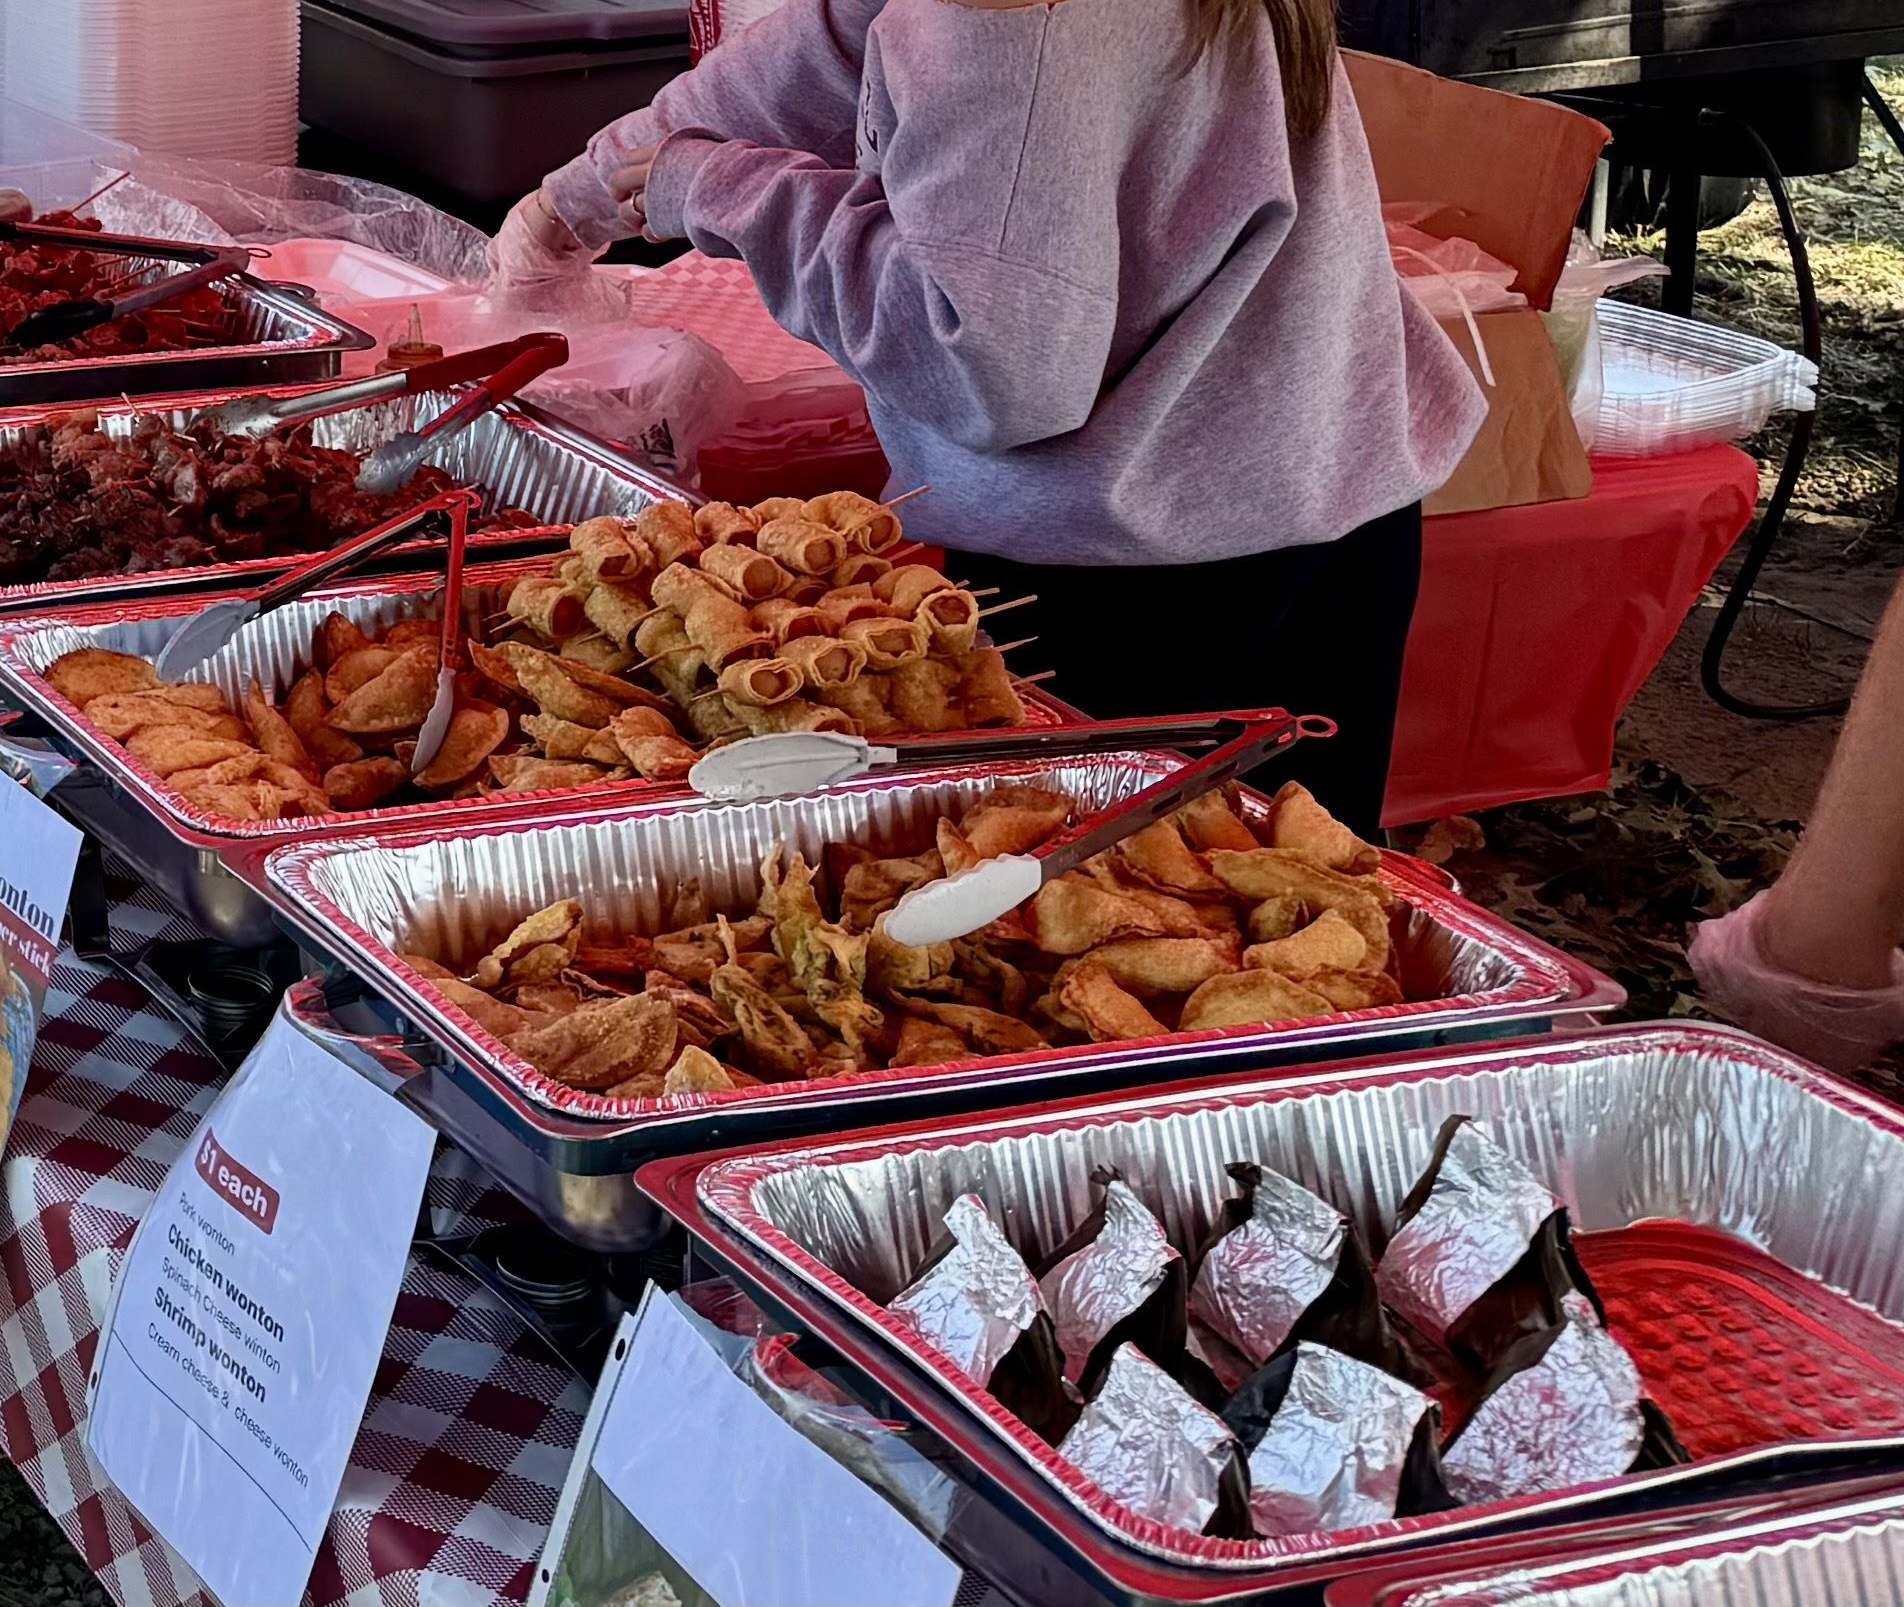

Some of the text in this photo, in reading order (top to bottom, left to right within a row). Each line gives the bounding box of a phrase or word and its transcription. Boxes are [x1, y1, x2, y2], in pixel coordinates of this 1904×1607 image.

[18, 938, 51, 976] stick
[200, 1139, 268, 1217] $1 each
[197, 1213, 235, 1257] wonton
[162, 1256, 202, 1304] Spinach
[202, 1295, 242, 1340] Cheese
[168, 1223, 284, 1343] Chicken wonton
[154, 1286, 267, 1403] Shrimp wonton
[148, 1322, 181, 1362] Cream
[235, 1406, 273, 1448] cheese
[273, 1443, 309, 1488] wonton
